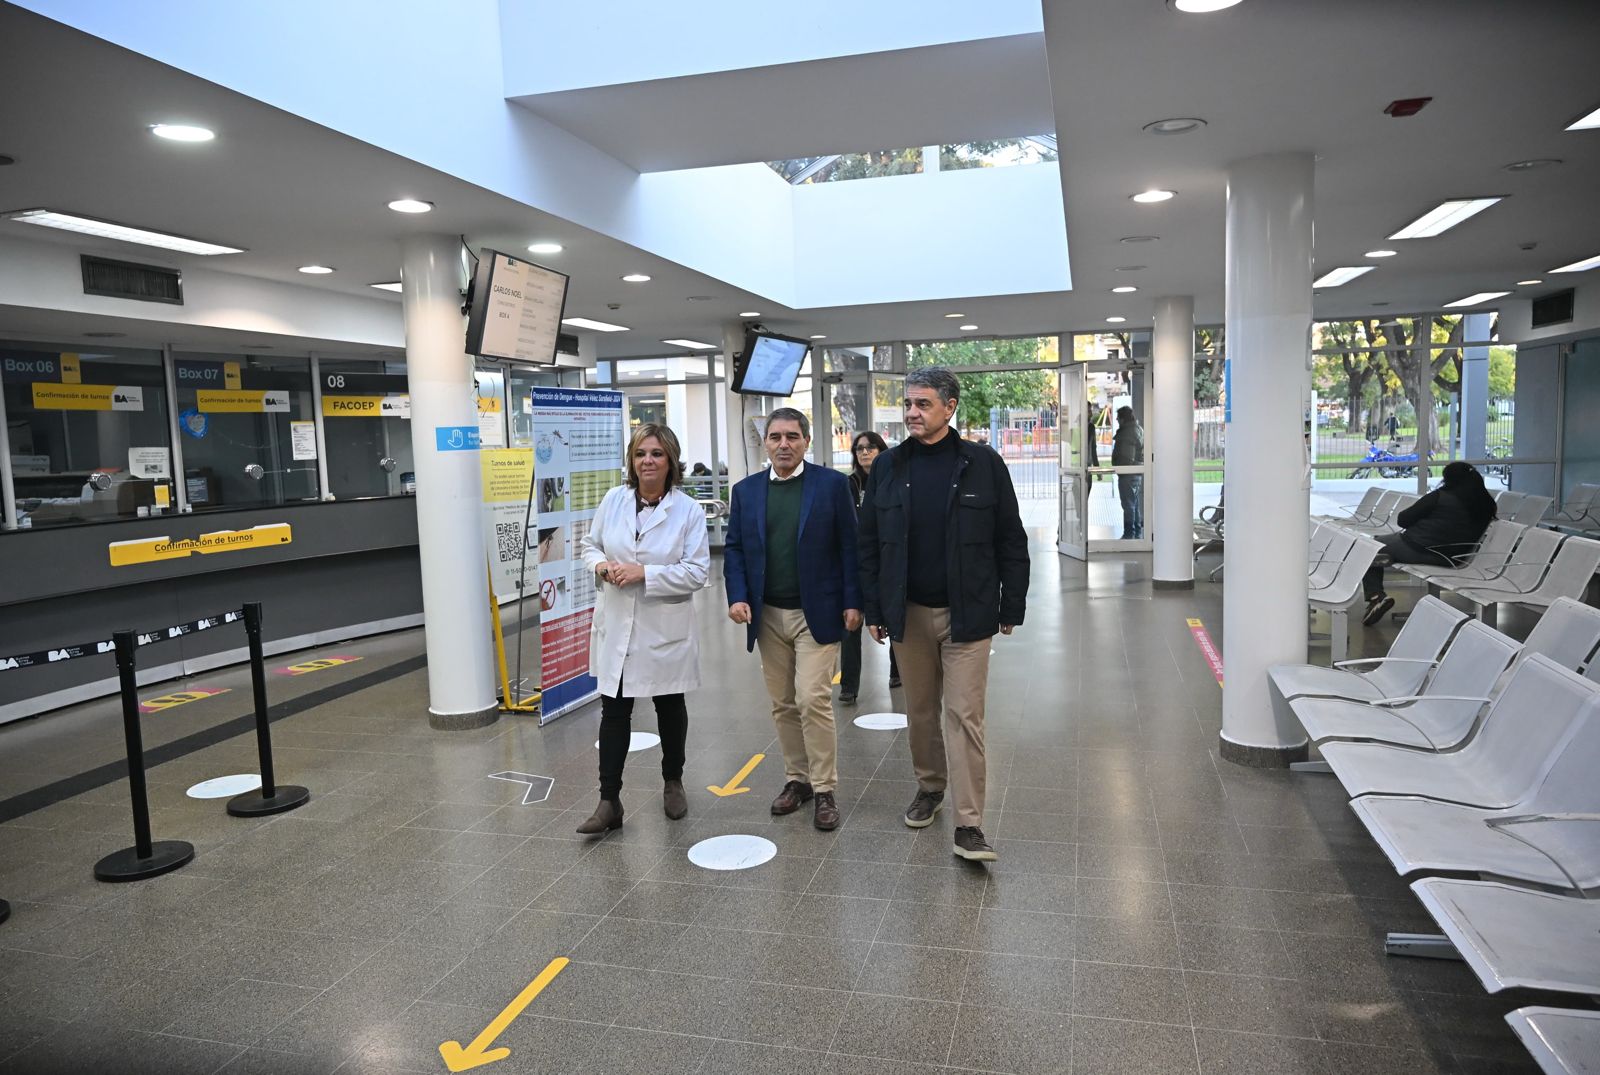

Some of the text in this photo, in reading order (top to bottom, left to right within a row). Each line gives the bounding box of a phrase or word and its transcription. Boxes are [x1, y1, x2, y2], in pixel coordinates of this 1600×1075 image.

[494, 284, 522, 299] CARLOS NOEL
[5, 359, 54, 373] Box 06
[178, 368, 218, 380] Box 07
[327, 375, 345, 388] 08
[36, 391, 79, 399] Confirmación
[114, 394, 128, 403] BA
[533, 391, 554, 400] Prevención
[559, 393, 573, 402] Dengue
[333, 401, 375, 410] FACOEP
[154, 533, 253, 552] Confirmación de turnos
[225, 611, 238, 623] BA
[197, 618, 211, 630] BA
[168, 626, 183, 638] BA
[137, 633, 152, 646] BA
[96, 640, 116, 653] BA
[48, 648, 71, 662] BA
